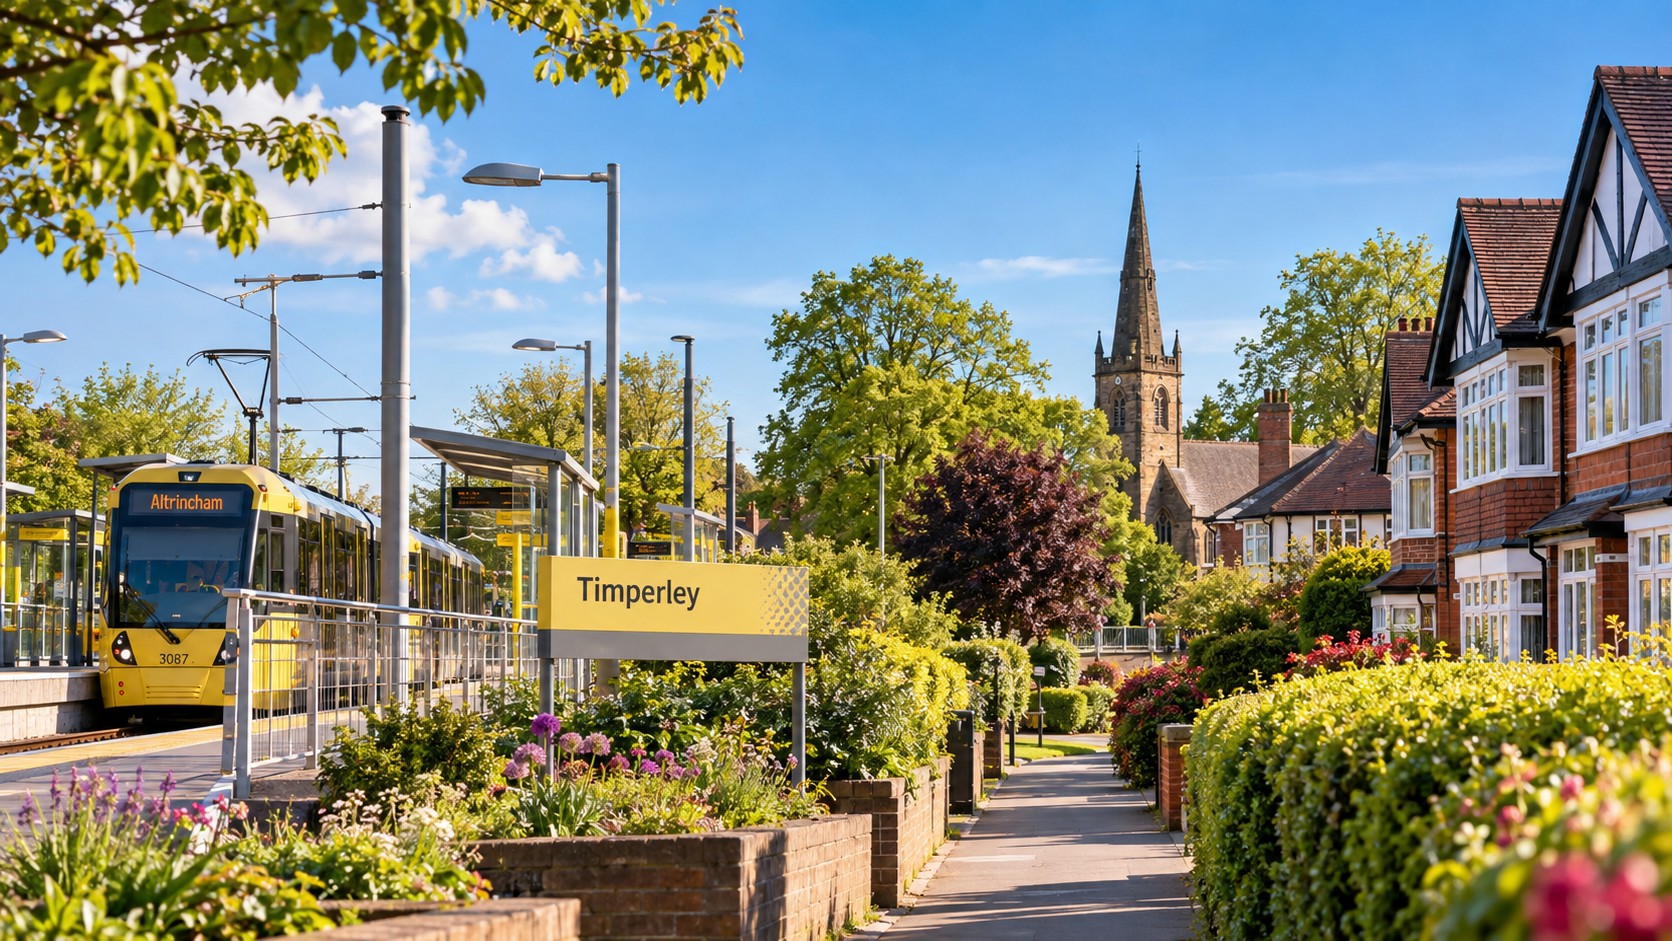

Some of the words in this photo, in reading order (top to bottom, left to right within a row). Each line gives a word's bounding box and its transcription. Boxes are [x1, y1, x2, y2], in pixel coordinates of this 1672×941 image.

[150, 493, 223, 510] Altrincham
[576, 576, 700, 611] Timperley
[159, 653, 189, 665] 3087
